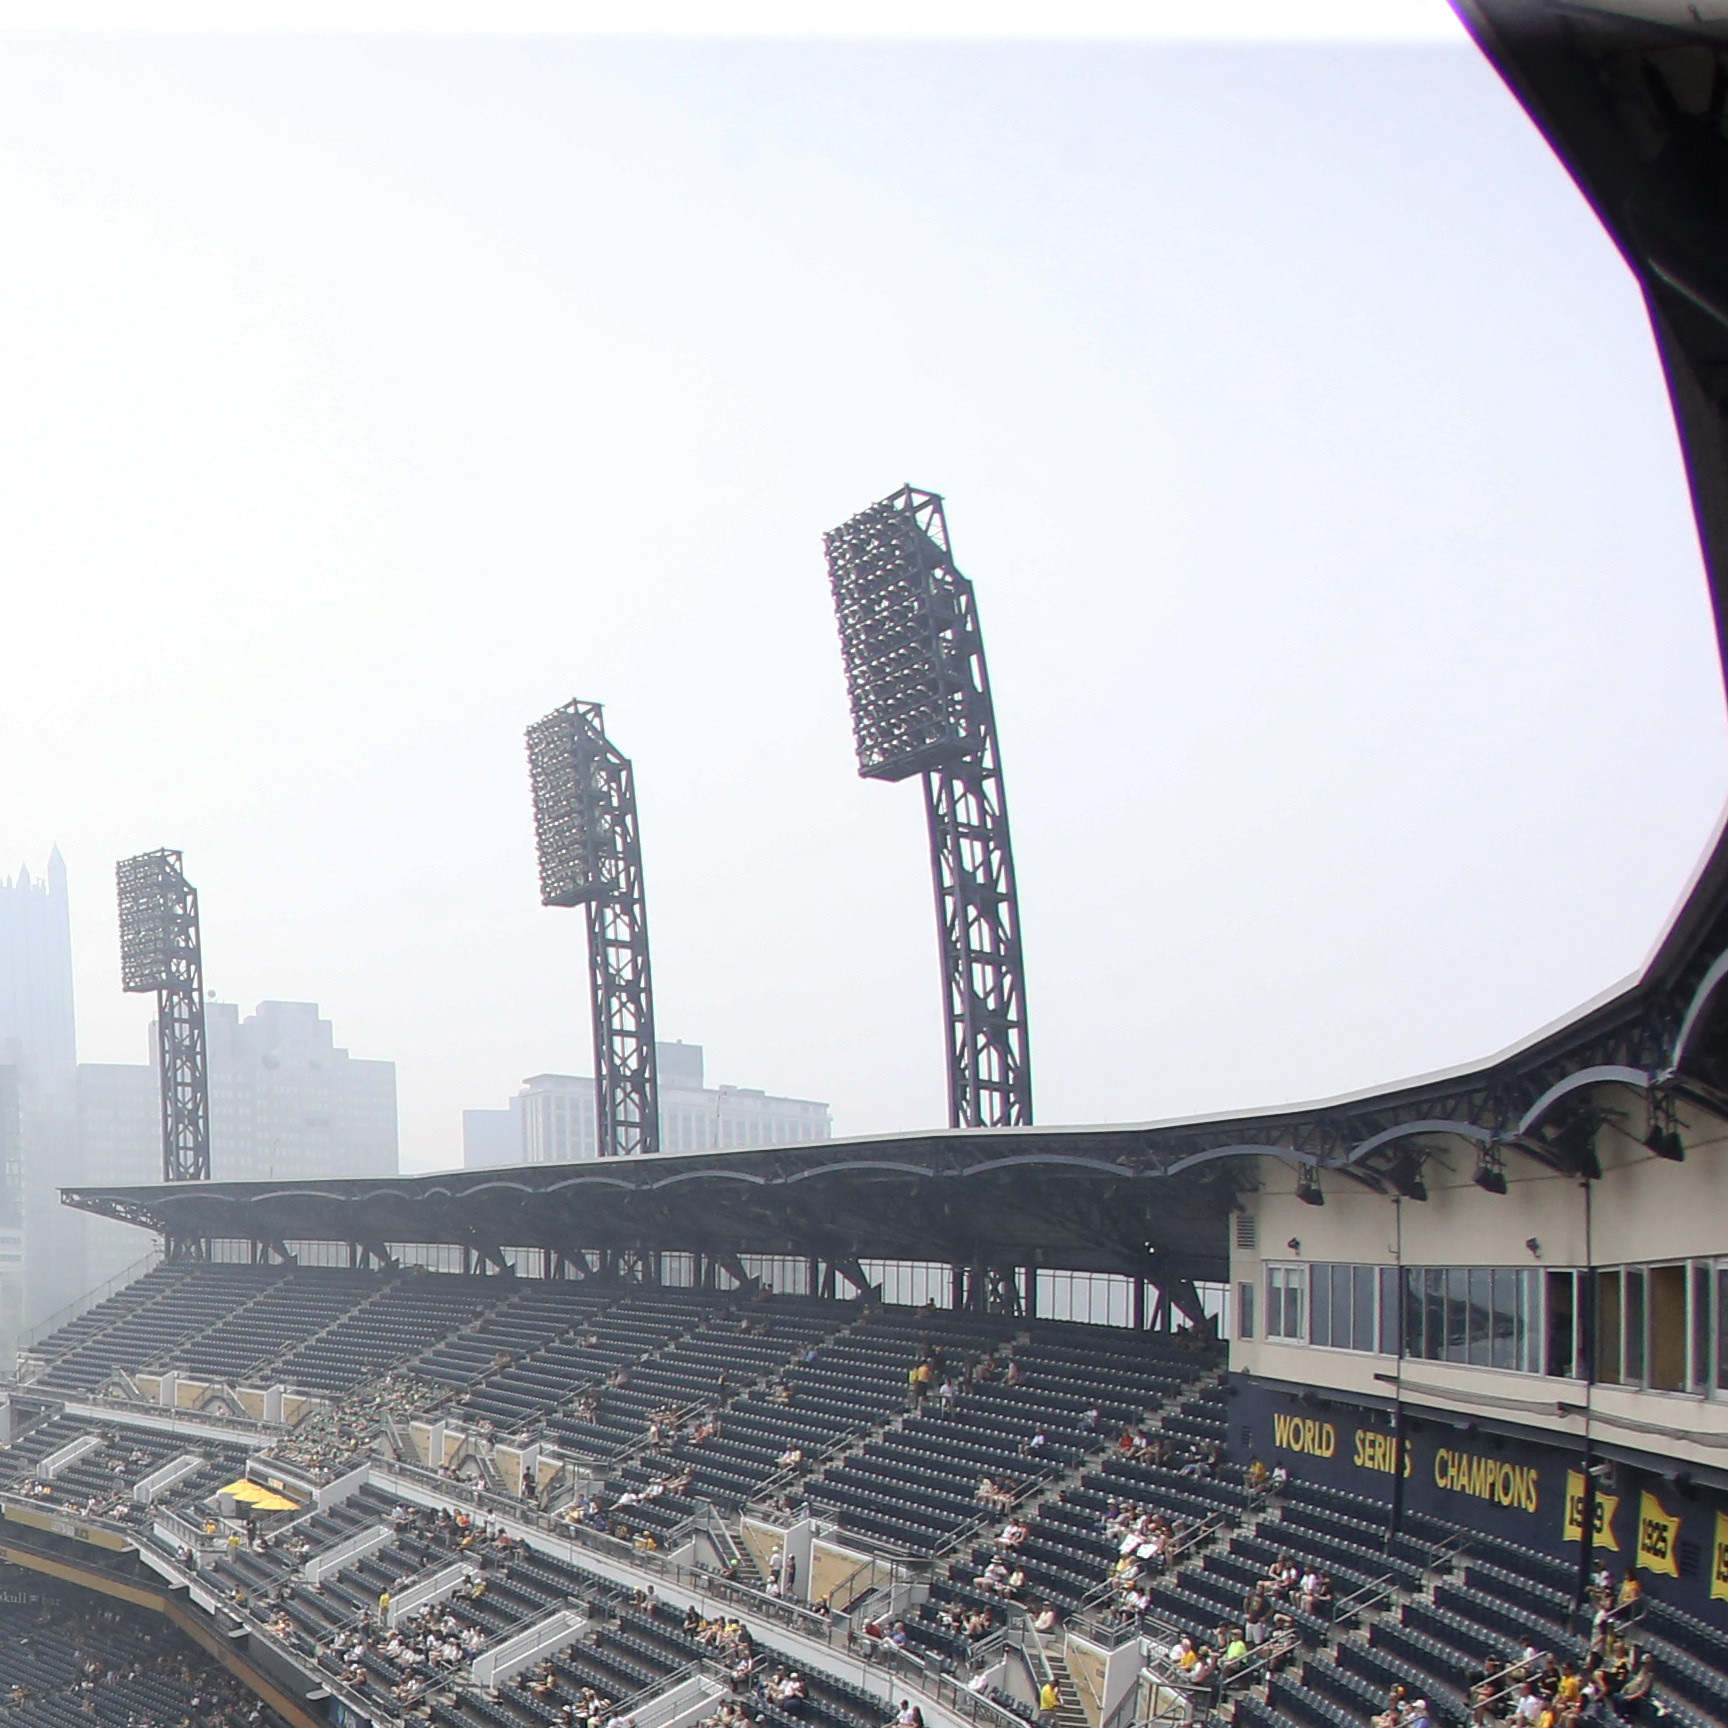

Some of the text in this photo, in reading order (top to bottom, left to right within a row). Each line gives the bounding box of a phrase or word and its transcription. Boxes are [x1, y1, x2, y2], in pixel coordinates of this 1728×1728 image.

[1272, 1412, 1337, 1458] WORLD
[1434, 1446, 1540, 1514] CHAMPIONS
[1569, 1495, 1605, 1534] 199
[1641, 1517, 1670, 1560] 1925
